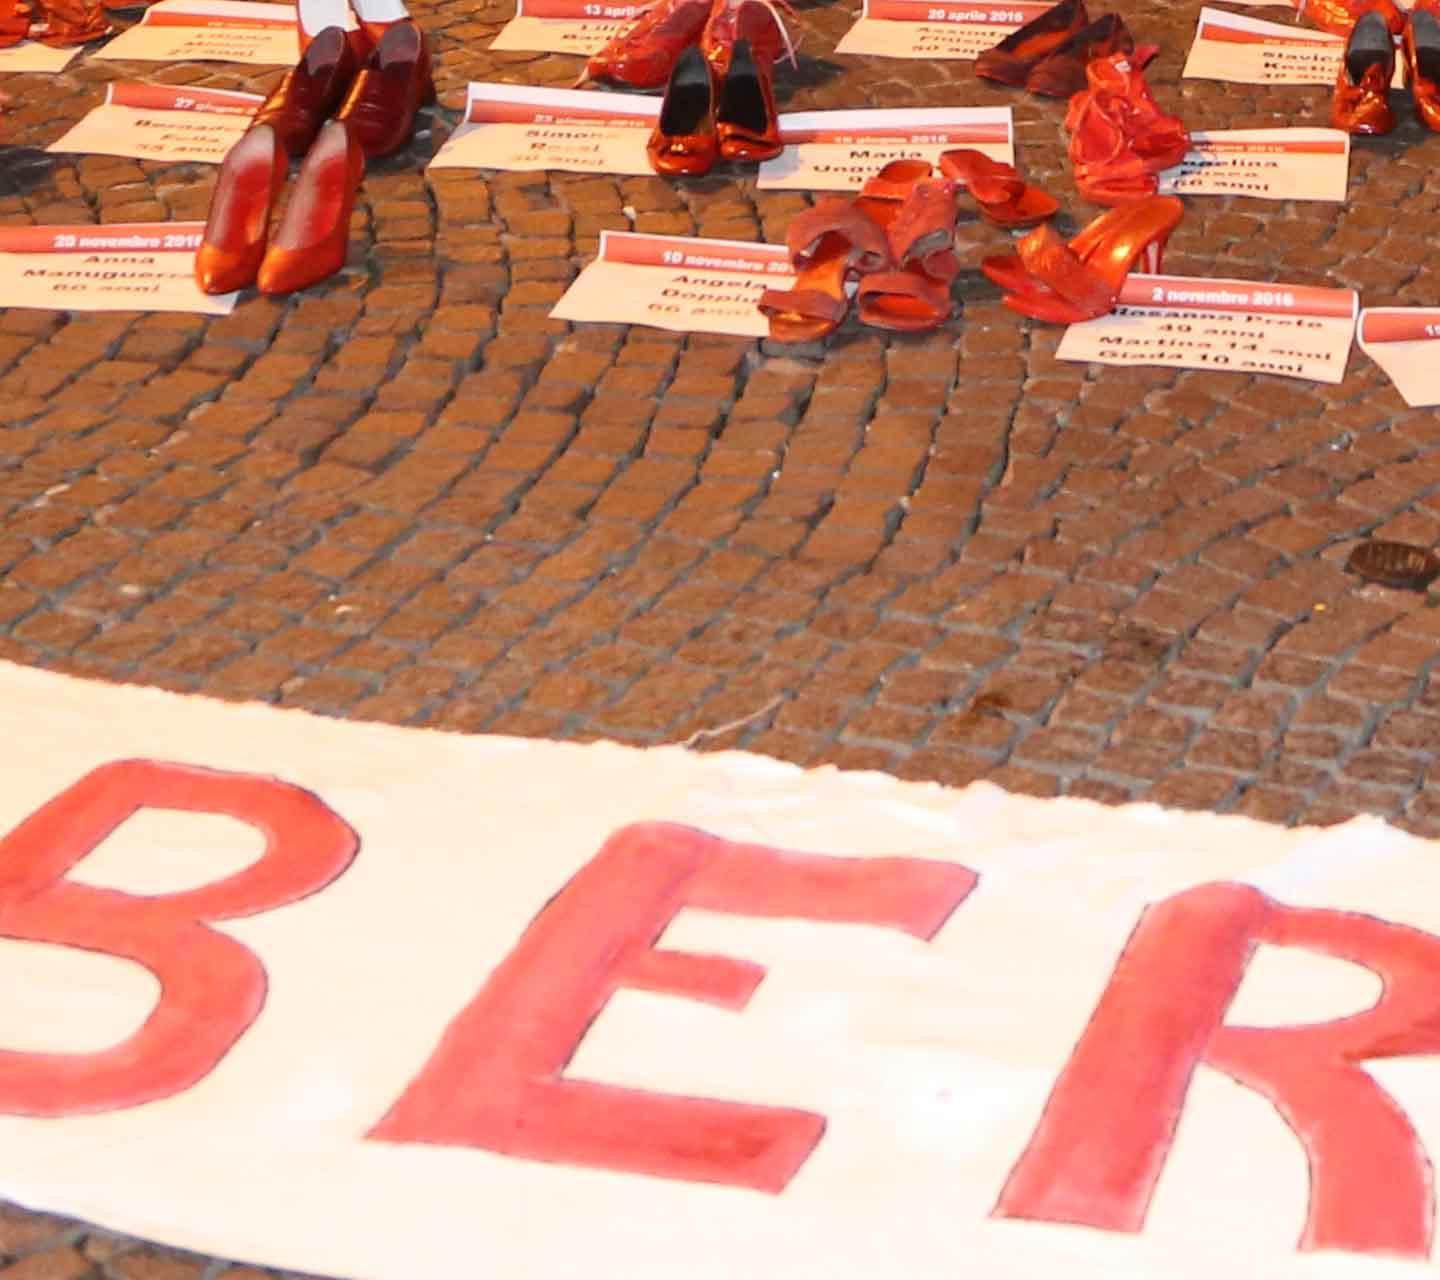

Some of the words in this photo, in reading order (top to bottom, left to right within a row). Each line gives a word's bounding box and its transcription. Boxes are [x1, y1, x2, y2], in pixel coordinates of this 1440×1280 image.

[947, 8, 988, 23] aprile
[848, 149, 923, 160] Maria
[79, 235, 162, 249] novembre
[82, 254, 156, 265] Anna
[686, 252, 766, 272] novembre
[96, 282, 162, 293] anni
[670, 274, 769, 291] Angela
[1166, 289, 1248, 307] novembre
[1201, 327, 1266, 339] anni
[1096, 335, 1213, 349] Martina
[1266, 347, 1333, 361] anni
[1095, 349, 1184, 361] Giada
[1240, 358, 1303, 373] anni
